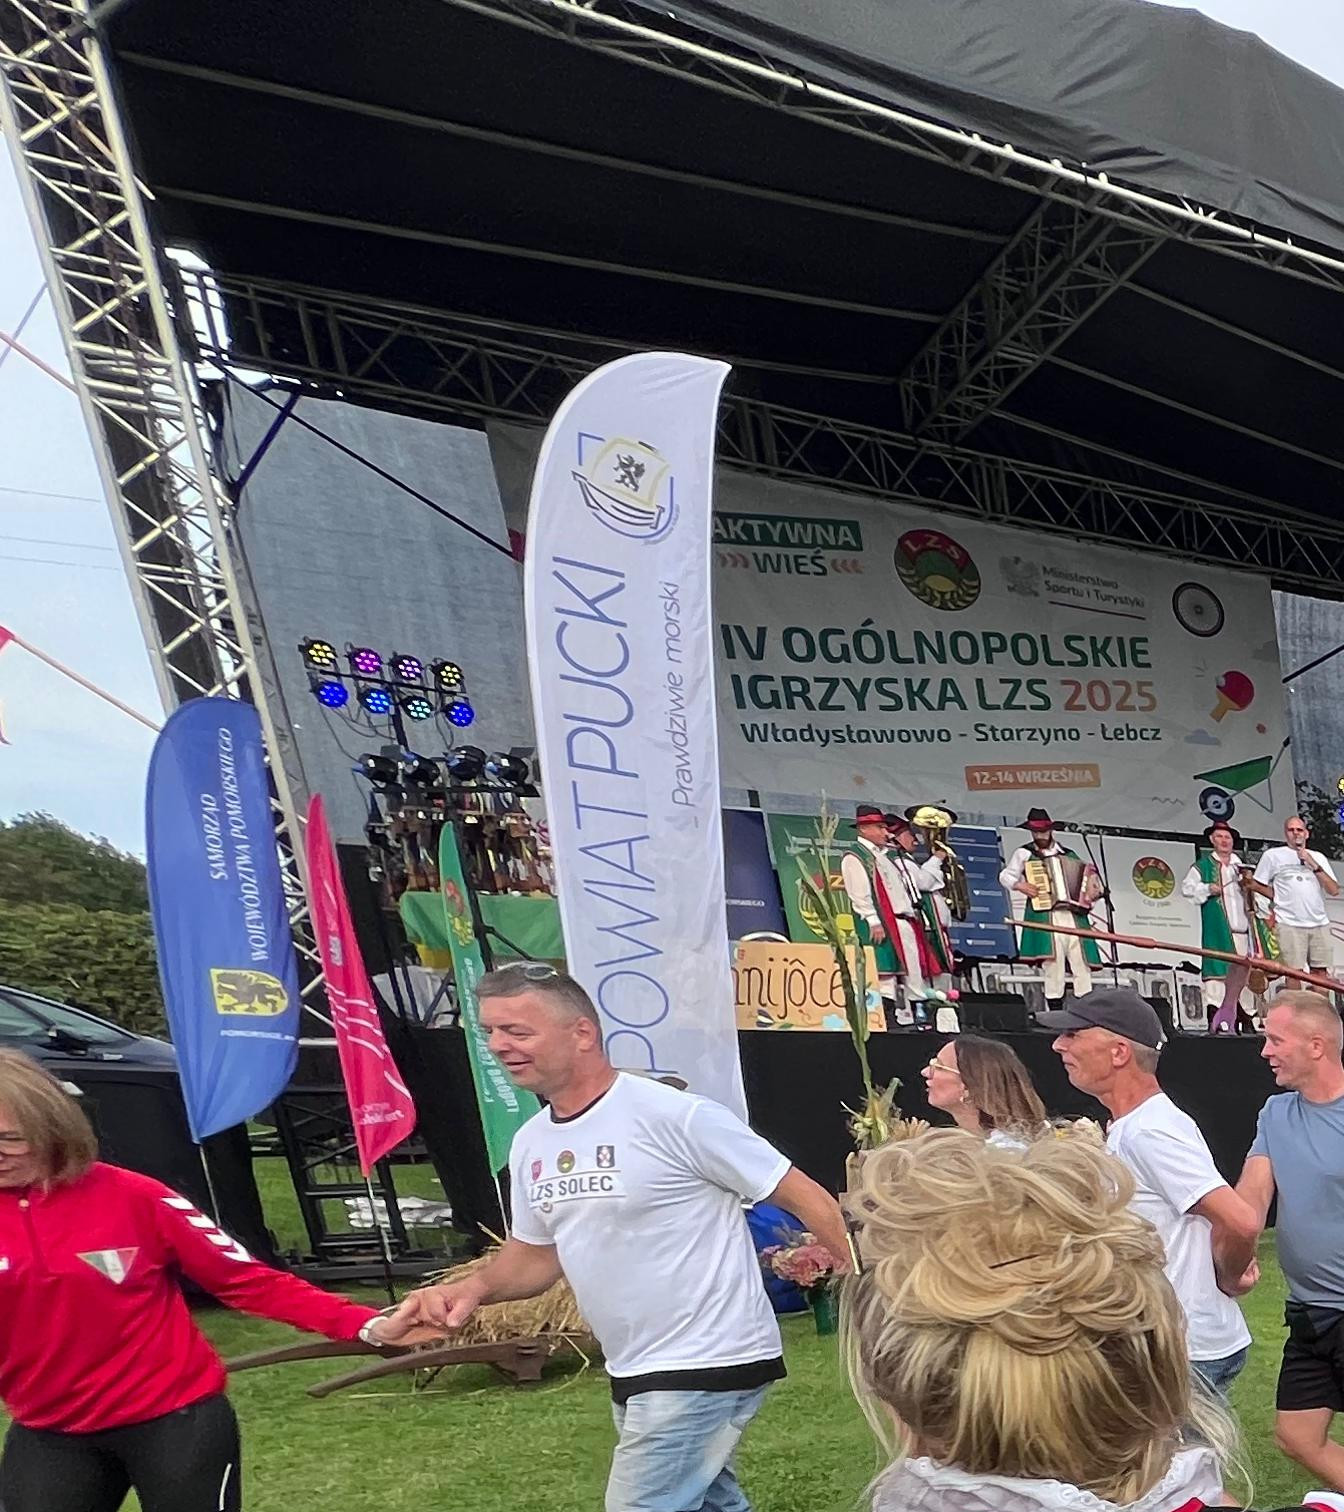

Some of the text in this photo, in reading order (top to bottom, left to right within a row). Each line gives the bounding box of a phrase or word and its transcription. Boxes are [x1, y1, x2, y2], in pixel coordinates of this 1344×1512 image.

[714, 518, 857, 547] AKTYWNA
[752, 549, 828, 576] WIEŚ
[658, 581, 684, 664] morski
[720, 617, 1152, 669] IV OGÓLNOPOLSKIE
[730, 673, 1158, 712] IGRZYSKA LZS 2025
[661, 670, 696, 808] Prawdziwie
[740, 722, 952, 748] Władysławowo
[973, 722, 1081, 746] Starzyno
[1100, 722, 1162, 742] Łebcz
[218, 727, 249, 840] POMORSKIEGO
[1016, 767, 1094, 785] WRZEŚNIA
[552, 556, 678, 1075] POWIAT PUCKI
[530, 1175, 614, 1202] LZS SOLEC
